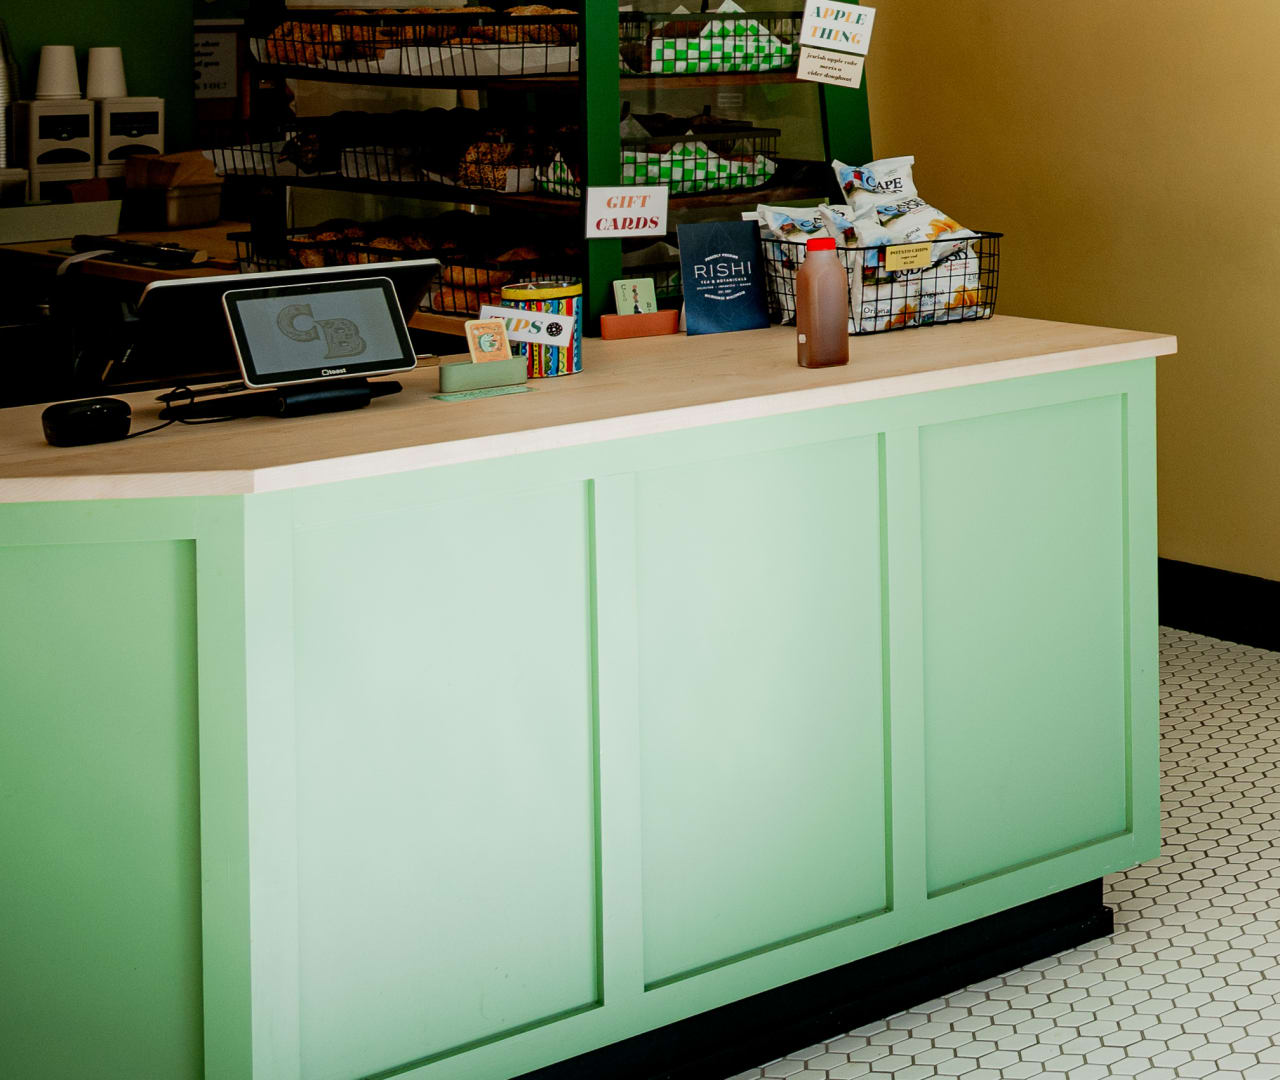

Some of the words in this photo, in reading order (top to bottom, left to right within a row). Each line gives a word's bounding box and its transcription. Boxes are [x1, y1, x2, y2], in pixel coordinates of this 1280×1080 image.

[810, 6, 868, 26] APPLE
[810, 25, 861, 44] THING
[606, 194, 651, 209] GIFT
[595, 216, 659, 231] CARDS
[694, 261, 752, 278] RISHI
